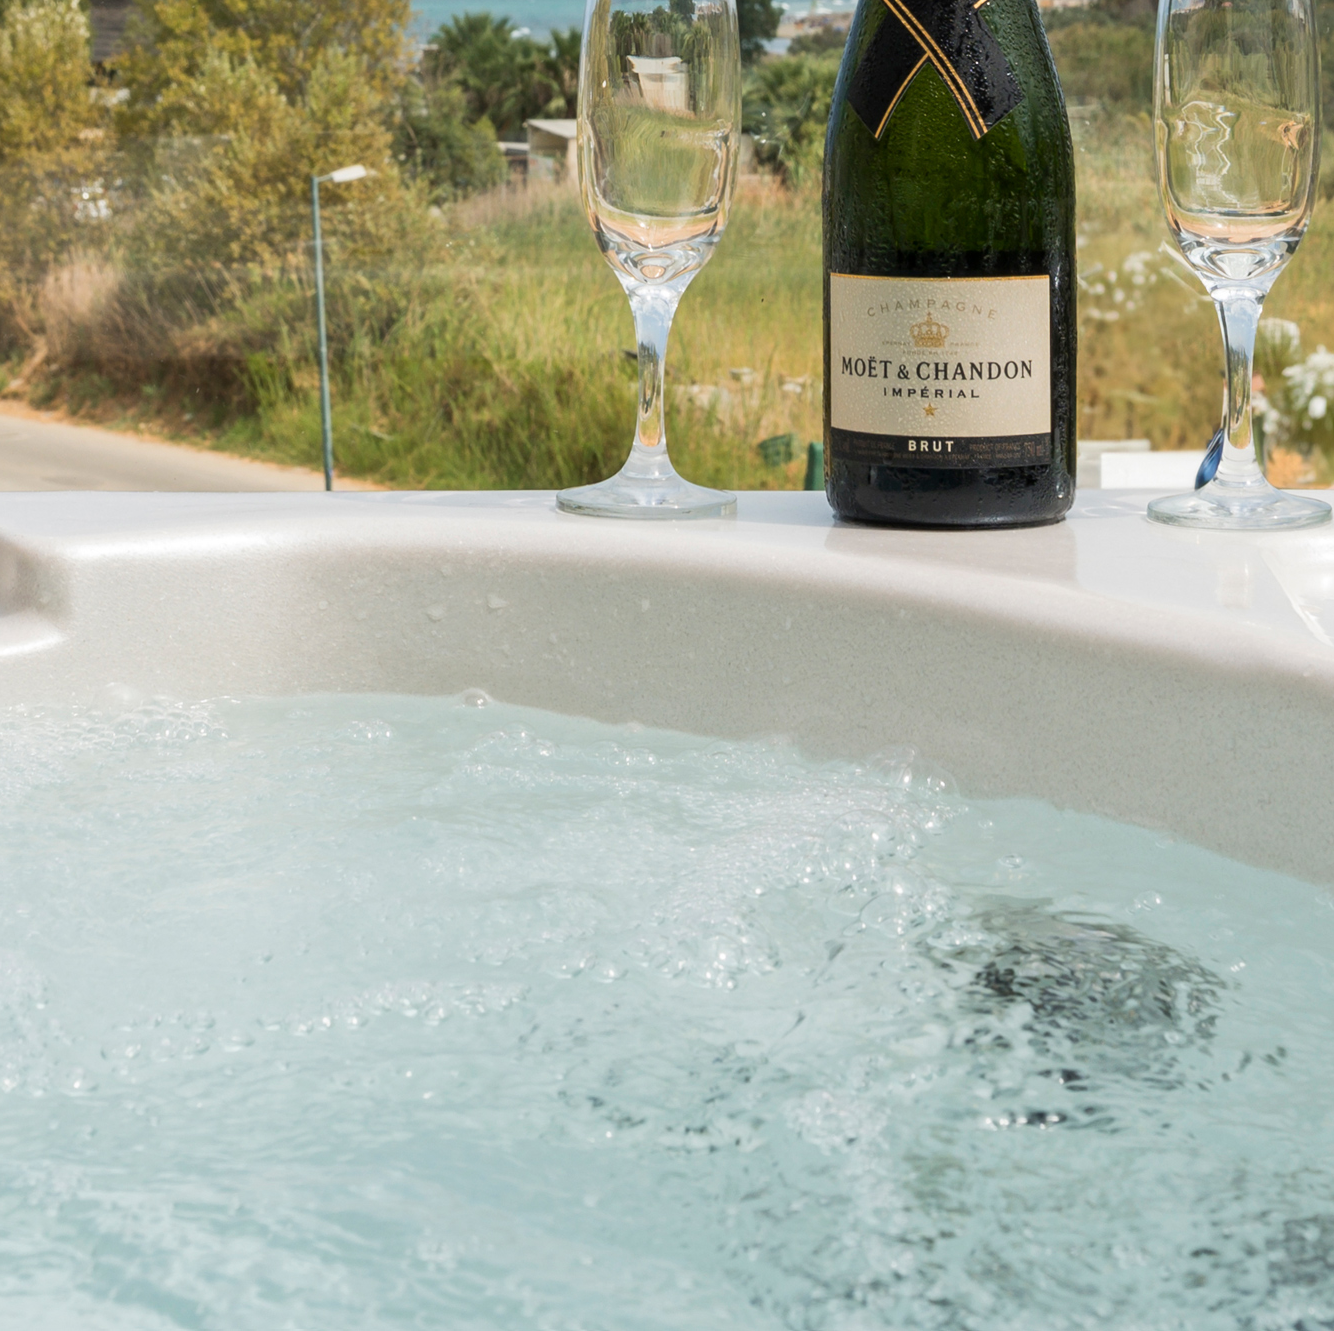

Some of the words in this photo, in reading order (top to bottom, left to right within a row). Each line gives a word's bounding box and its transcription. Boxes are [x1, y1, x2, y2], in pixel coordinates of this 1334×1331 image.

[867, 298, 997, 320] CHAMPAGNE
[841, 356, 892, 379] MOËT
[897, 364, 911, 380] &
[915, 359, 1033, 381] CHANDON
[883, 386, 980, 399] IMPÉRIAL
[908, 439, 954, 452] BRUT
